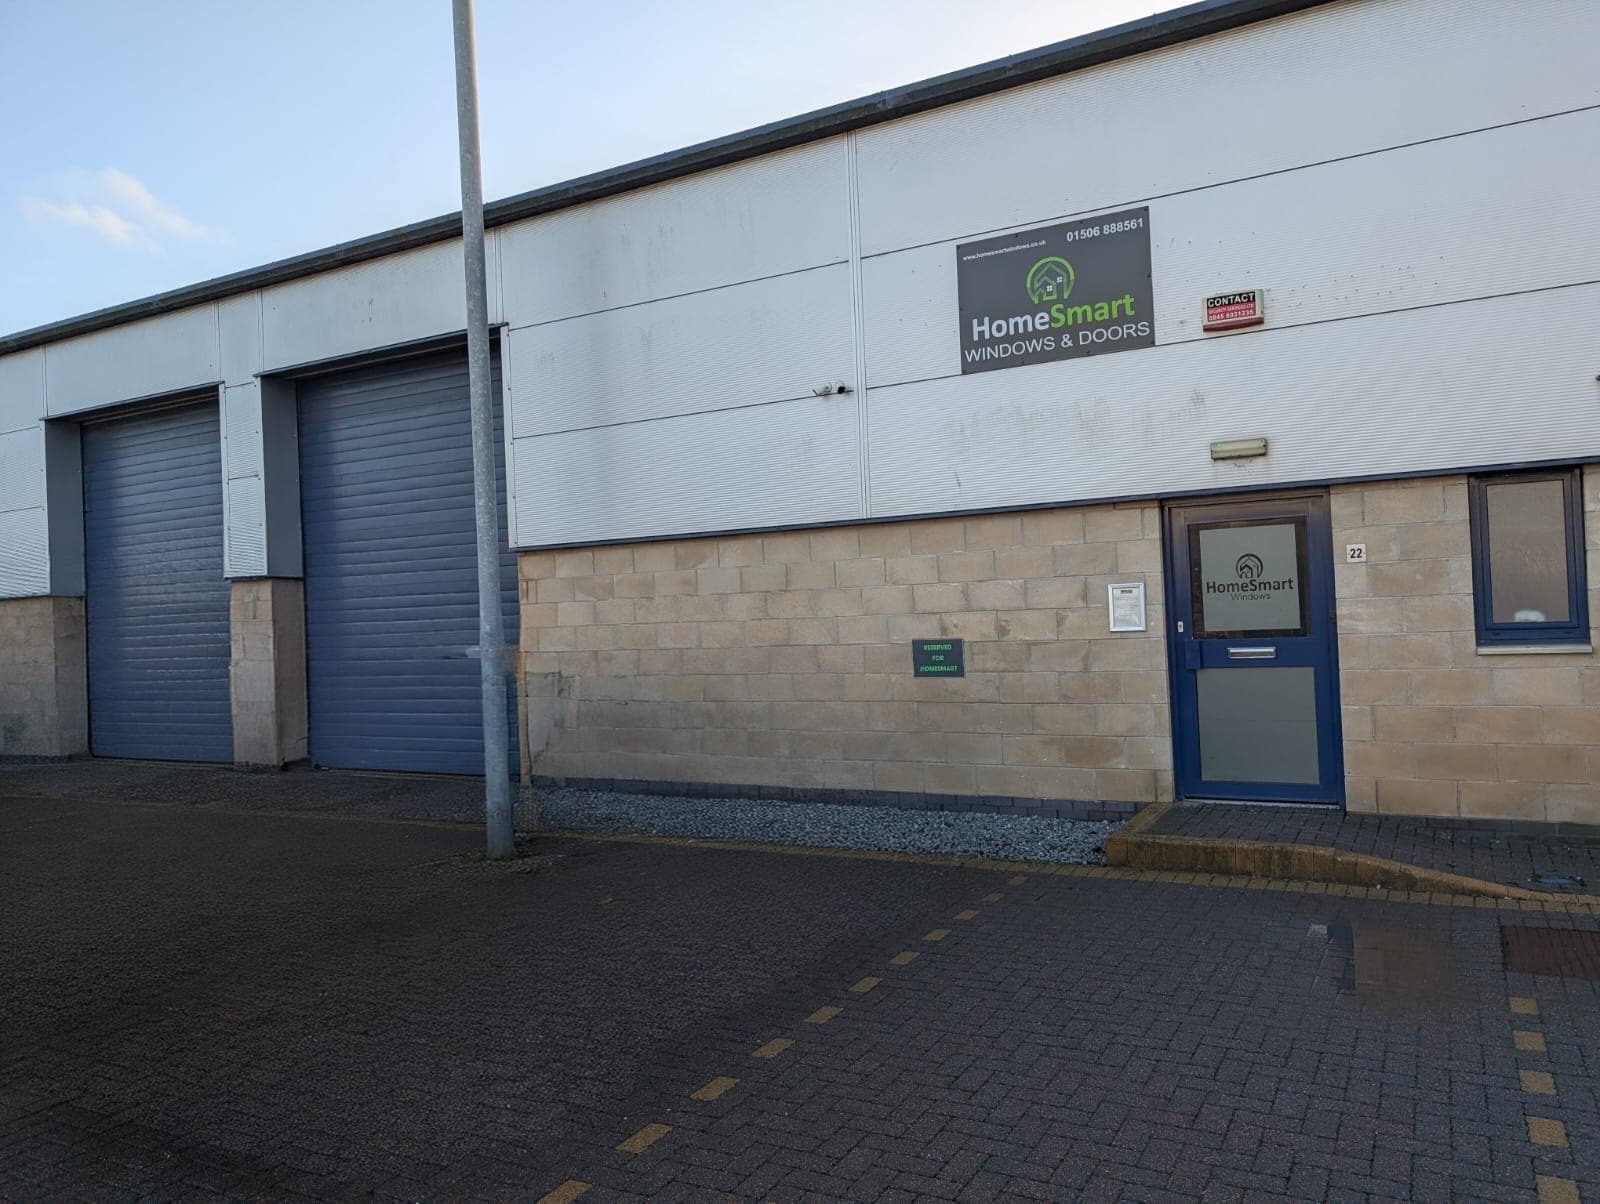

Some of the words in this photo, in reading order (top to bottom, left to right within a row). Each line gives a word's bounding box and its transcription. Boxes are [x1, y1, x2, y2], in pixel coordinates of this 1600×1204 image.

[1066, 227, 1100, 242] 01506
[1103, 217, 1144, 236] 888561
[963, 240, 1046, 260] www.homesmartwindows.co.uk
[1207, 292, 1255, 308] CONTACT
[972, 294, 1135, 342] HomeSmart
[965, 336, 1056, 363] WINDOWS
[1060, 333, 1074, 348] &
[1078, 321, 1151, 345] DOORS
[1350, 548, 1363, 559] 22
[1206, 578, 1294, 594] HomeSmart
[1230, 593, 1272, 601] Windows
